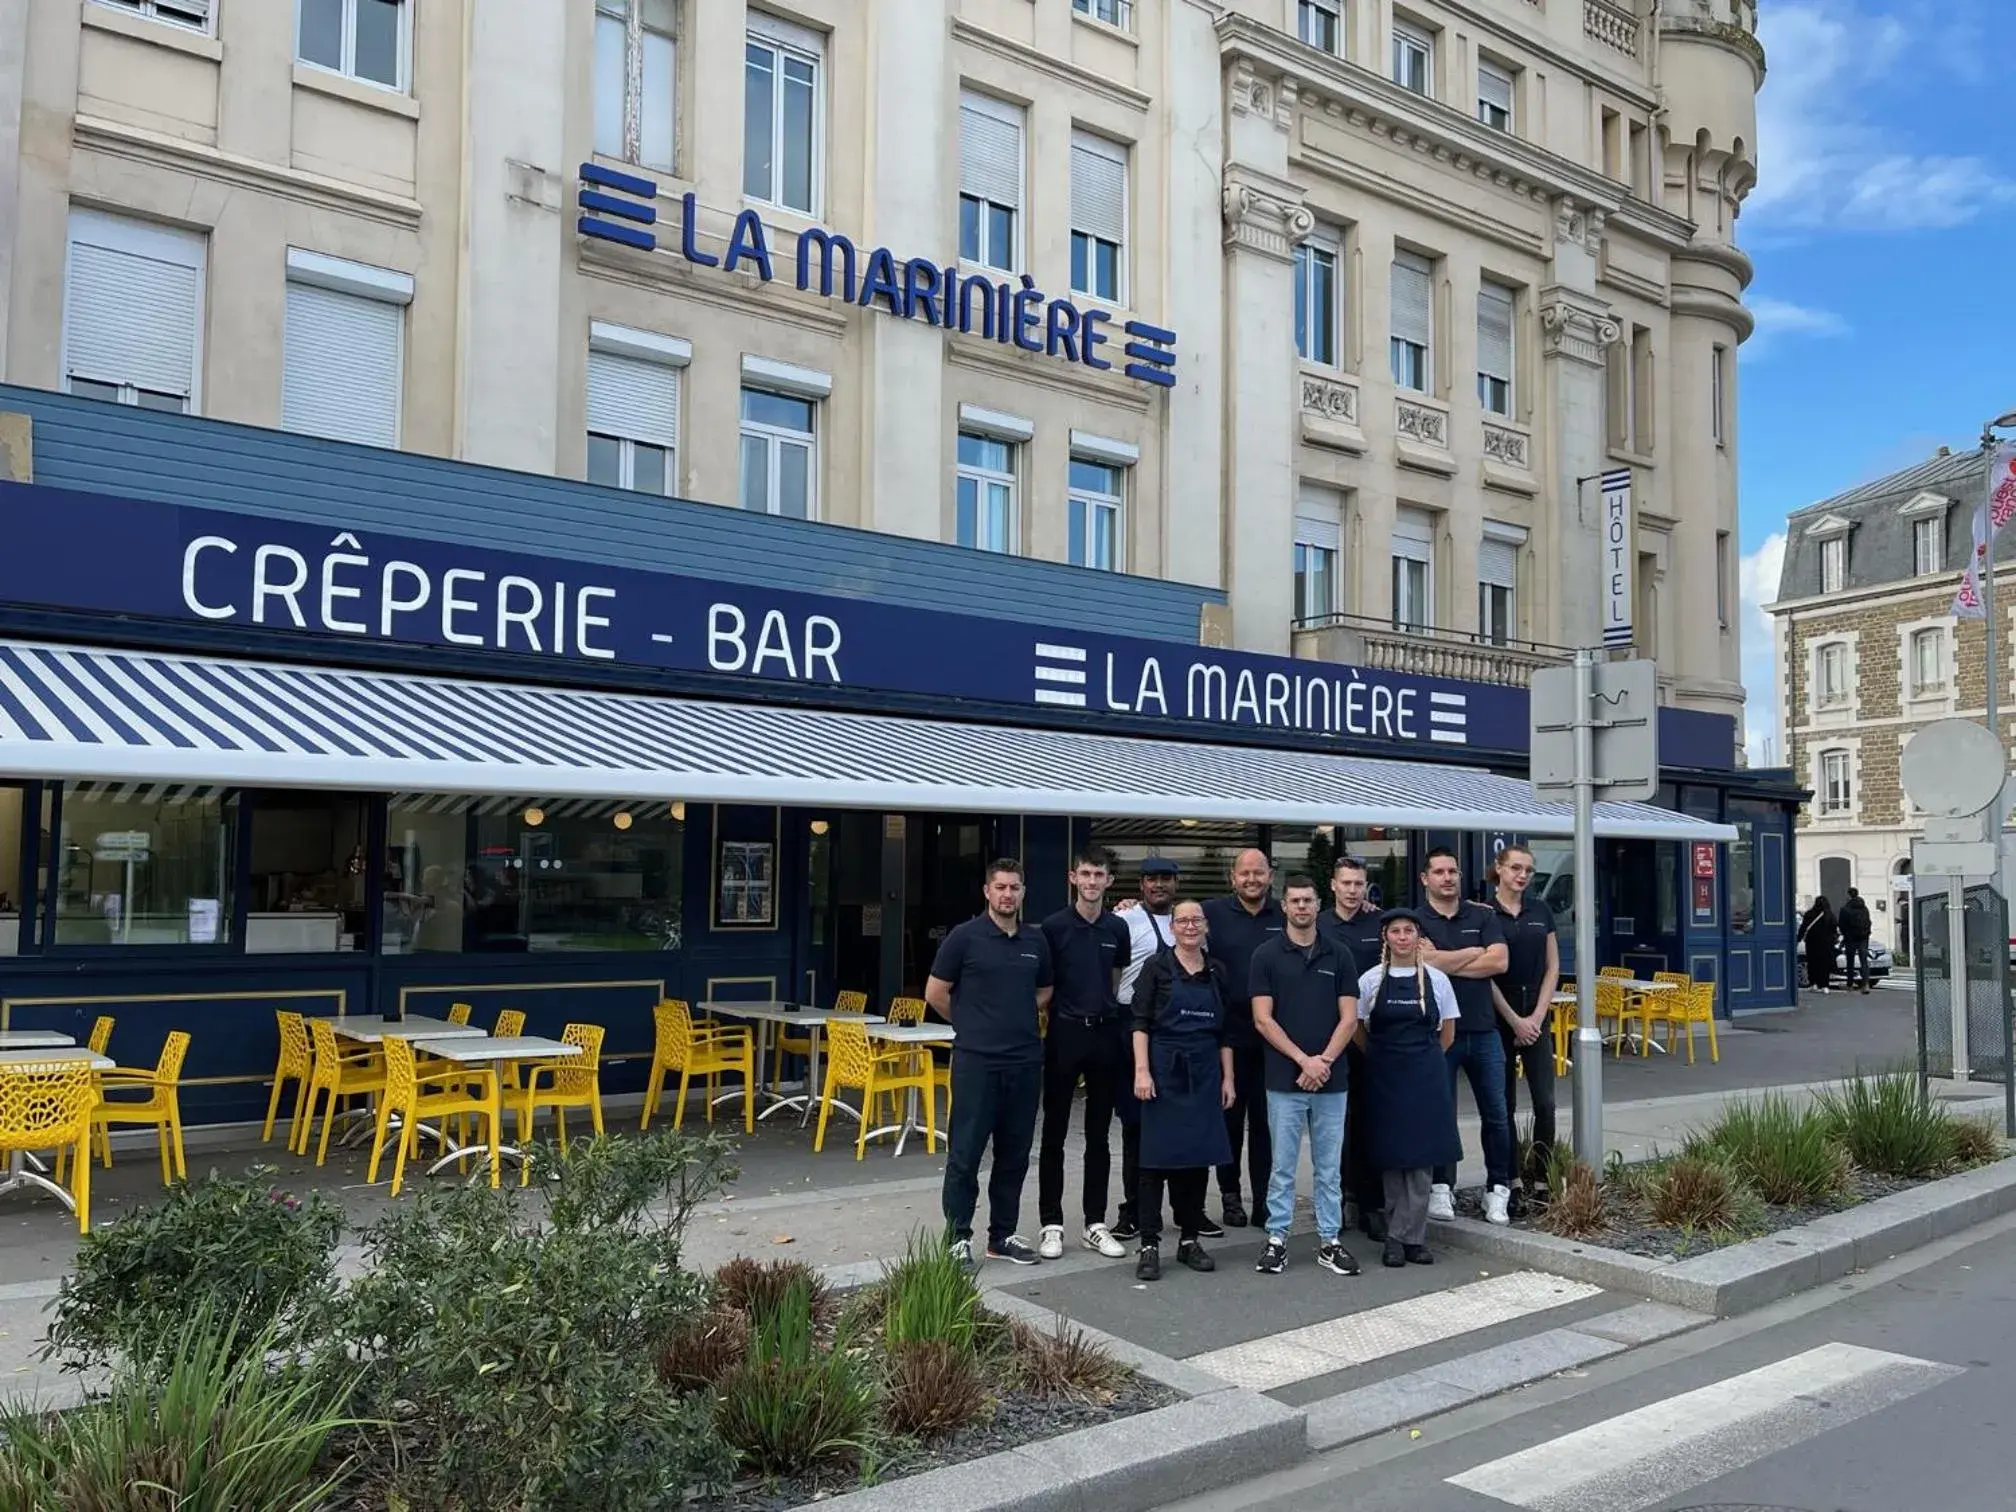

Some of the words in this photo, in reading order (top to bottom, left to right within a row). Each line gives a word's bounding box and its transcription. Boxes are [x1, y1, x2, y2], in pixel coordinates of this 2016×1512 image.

[682, 192, 773, 283] LA
[796, 227, 1112, 371] MARINIÈRE
[182, 529, 617, 660] CRÊPERIE
[651, 632, 673, 644] -
[707, 602, 843, 683] BAR
[1609, 494, 1624, 622] HÔTEL
[1106, 651, 1169, 716] LA
[1187, 662, 1418, 739] MARINIÈRE
